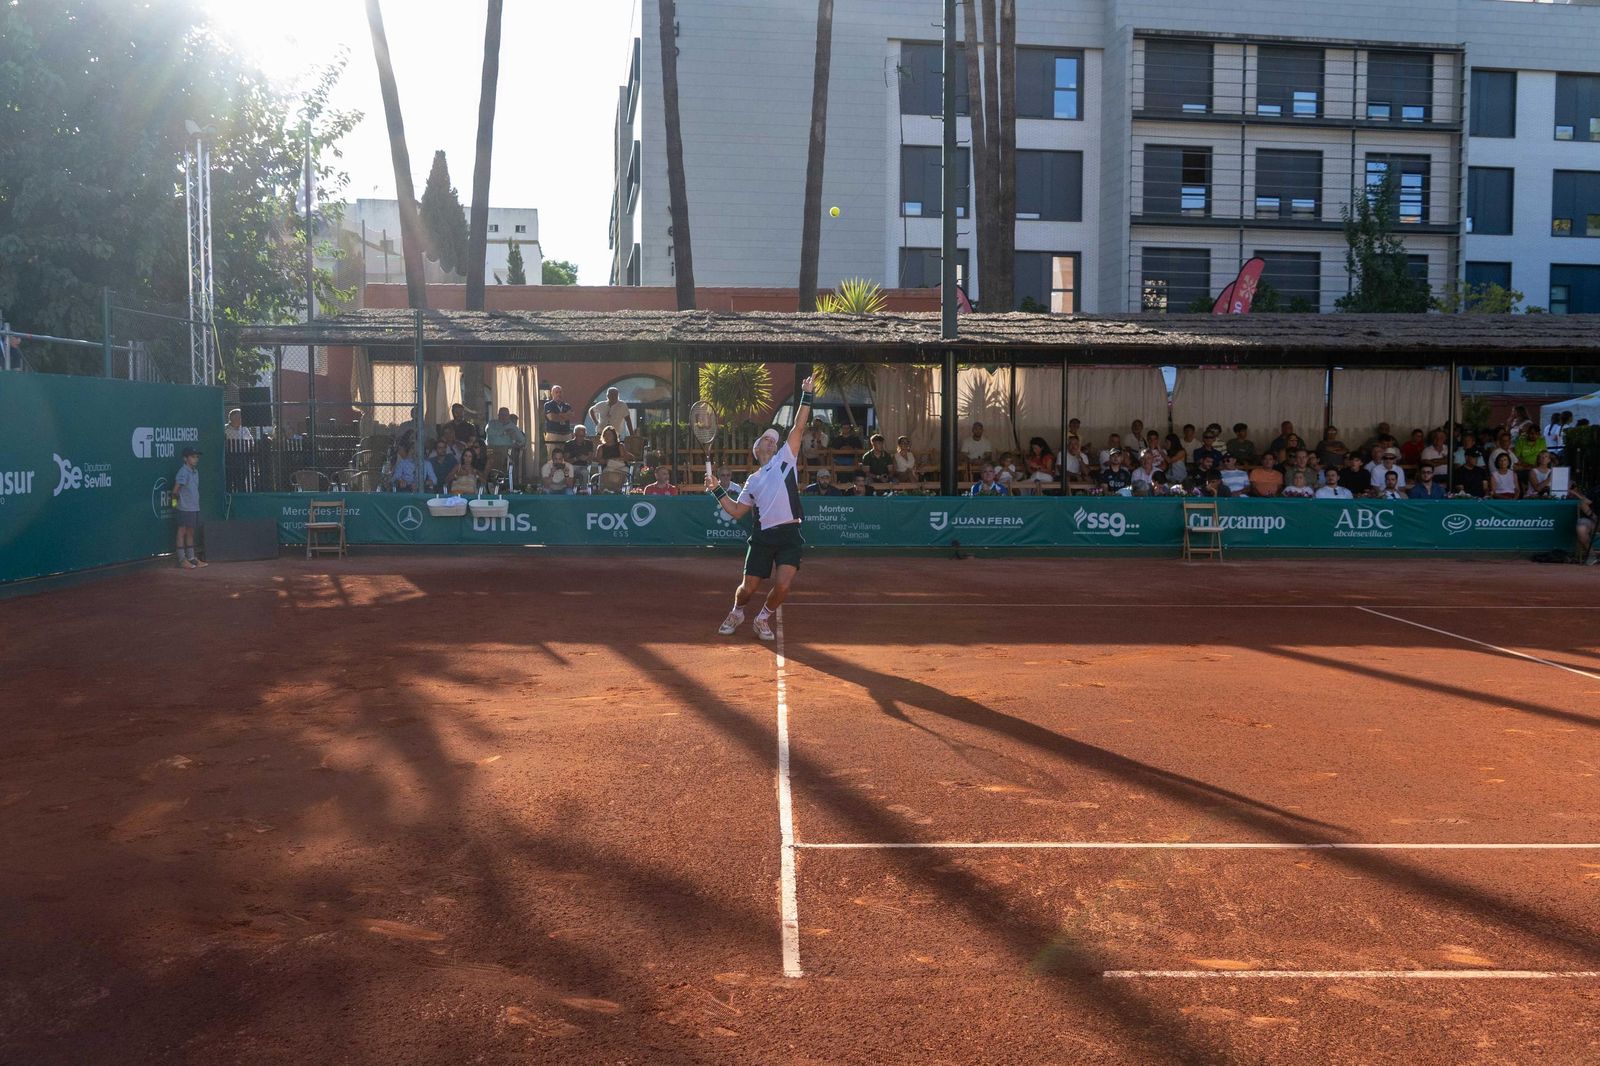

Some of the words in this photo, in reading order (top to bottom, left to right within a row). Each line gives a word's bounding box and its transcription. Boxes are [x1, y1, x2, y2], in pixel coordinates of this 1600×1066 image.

[155, 427, 199, 442] CHALLENGER
[155, 443, 175, 458] TOUR
[84, 473, 112, 489] Sevilla
[819, 505, 855, 513] Montero
[586, 512, 629, 531] FOX
[951, 517, 986, 525] JUAN
[987, 517, 1024, 525] FERIA
[1334, 508, 1394, 529] ABC
[1475, 516, 1555, 528] solocanarias
[706, 529, 748, 537] PROCISA
[840, 531, 869, 539] Atencia
[1333, 530, 1393, 538] abcdesevilla.es
